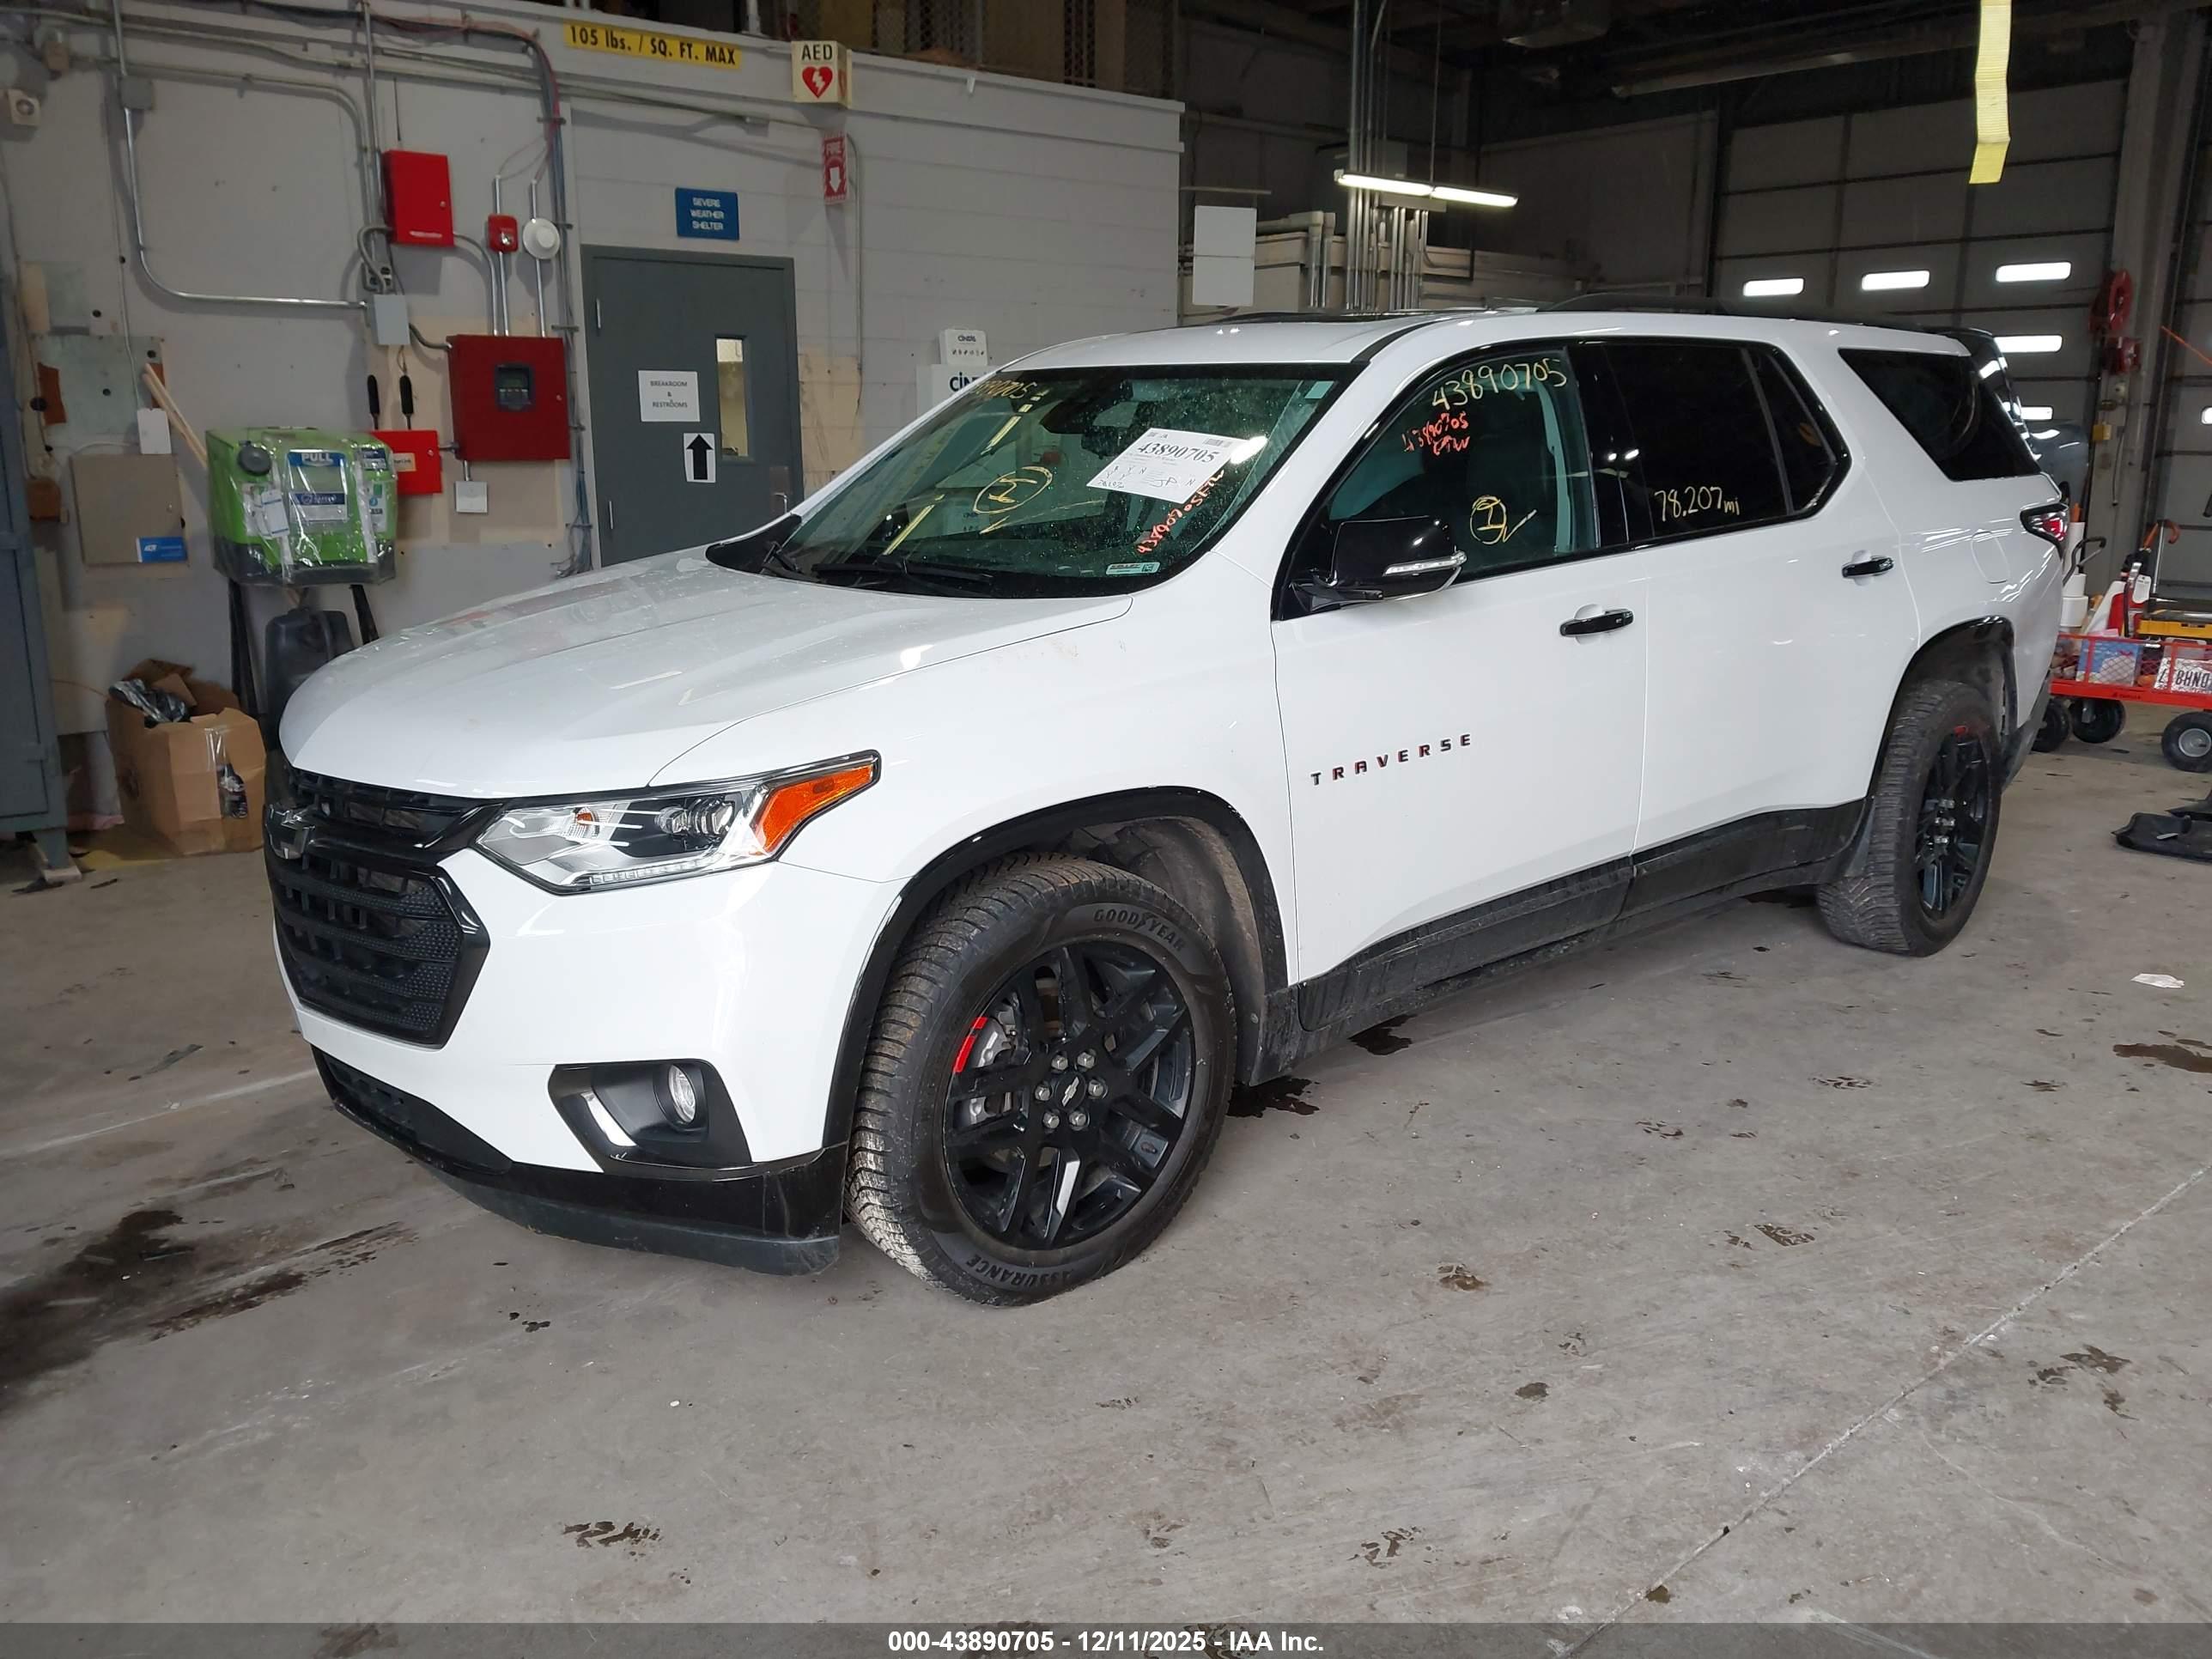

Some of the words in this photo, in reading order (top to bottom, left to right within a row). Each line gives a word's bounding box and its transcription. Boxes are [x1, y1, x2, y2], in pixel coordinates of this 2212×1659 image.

[570, 25, 599, 46] 105
[605, 29, 631, 51] lbs.
[638, 28, 643, 52] /
[650, 40, 672, 58] SQ.
[679, 44, 700, 60] FT.
[704, 47, 736, 65] MAX
[801, 43, 833, 61] AED
[692, 197, 721, 208] SEVERE
[690, 209, 725, 220] WEATHER
[691, 220, 724, 231] SHELTER
[1432, 357, 1567, 410] 43890705
[301, 453, 333, 462] PULL
[1138, 442, 1220, 464] 43890705
[1310, 733, 1471, 786] TRAVERSE
[1093, 908, 1184, 951] GOODYEAR
[965, 1254, 1072, 1287] ASSURANCE
